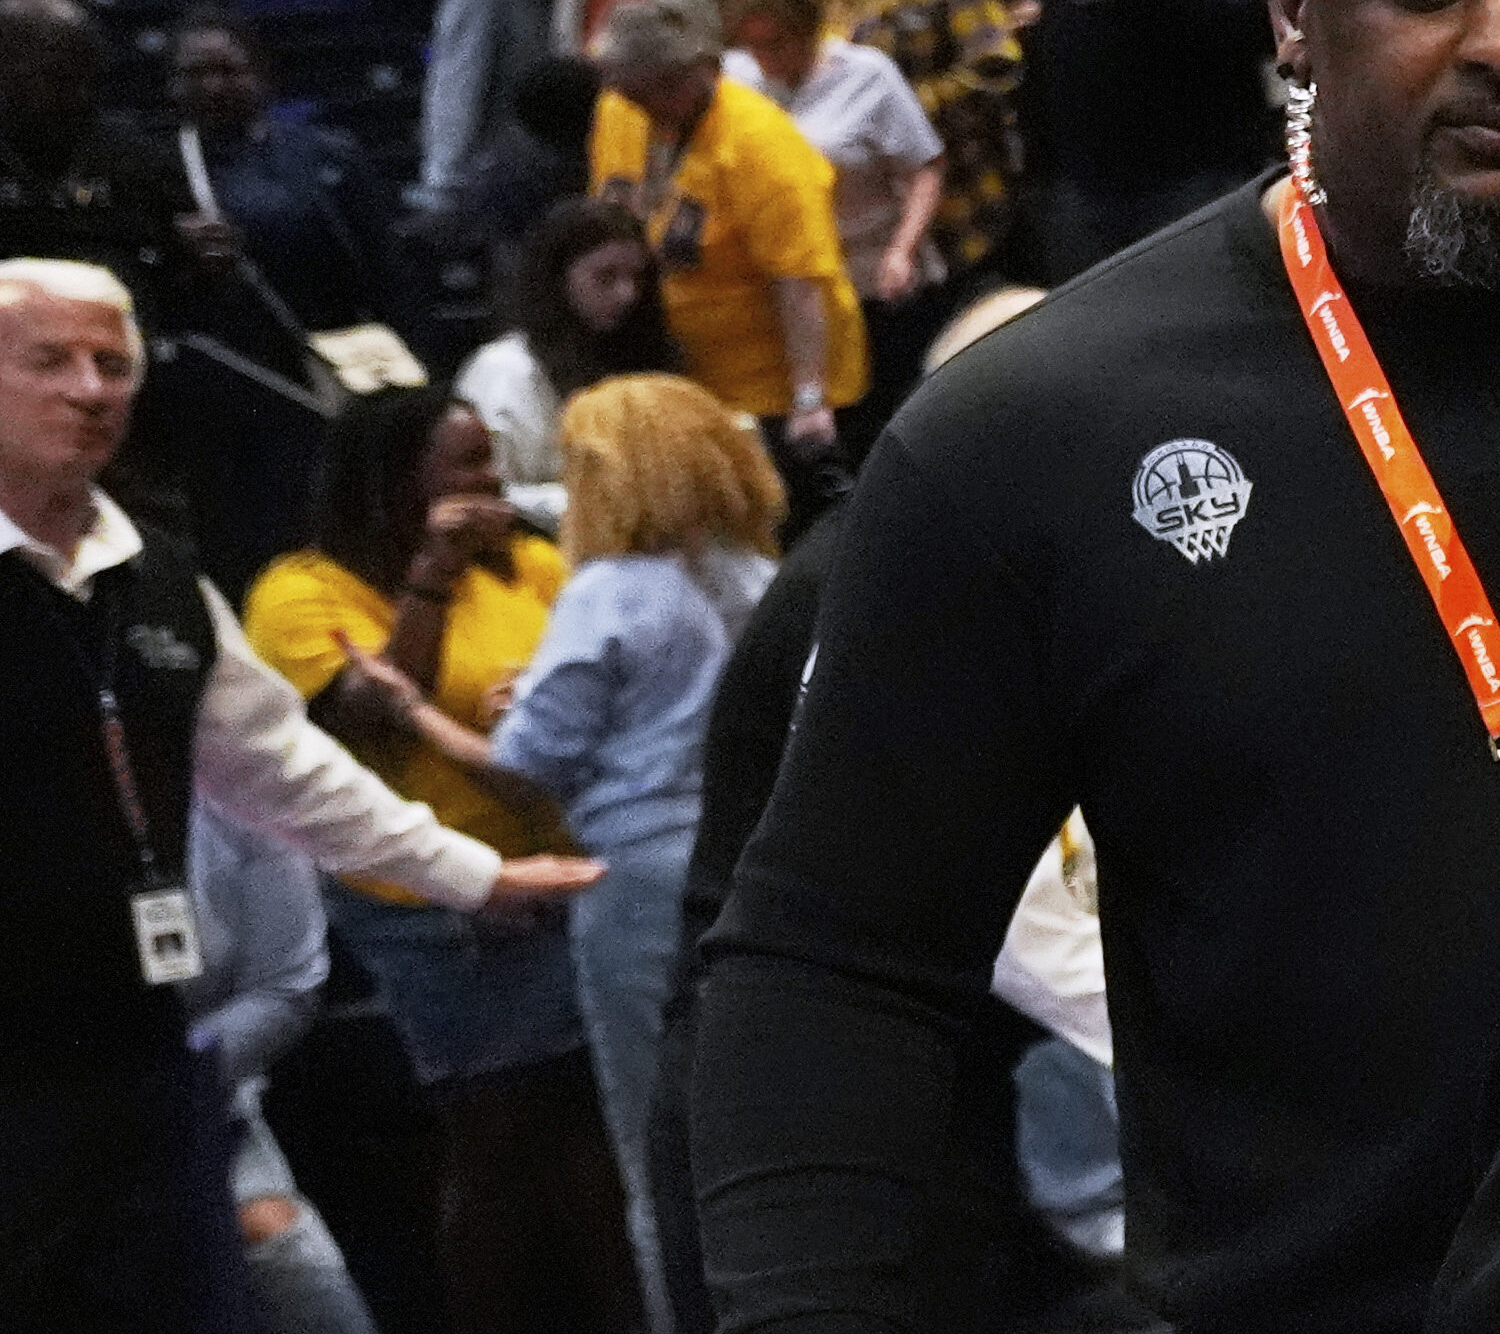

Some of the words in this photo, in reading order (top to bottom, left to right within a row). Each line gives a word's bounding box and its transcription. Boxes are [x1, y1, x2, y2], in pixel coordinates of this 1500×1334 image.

[1318, 305, 1350, 363] WNBA
[1362, 402, 1395, 462] WNBA
[1416, 516, 1452, 580] WNBA
